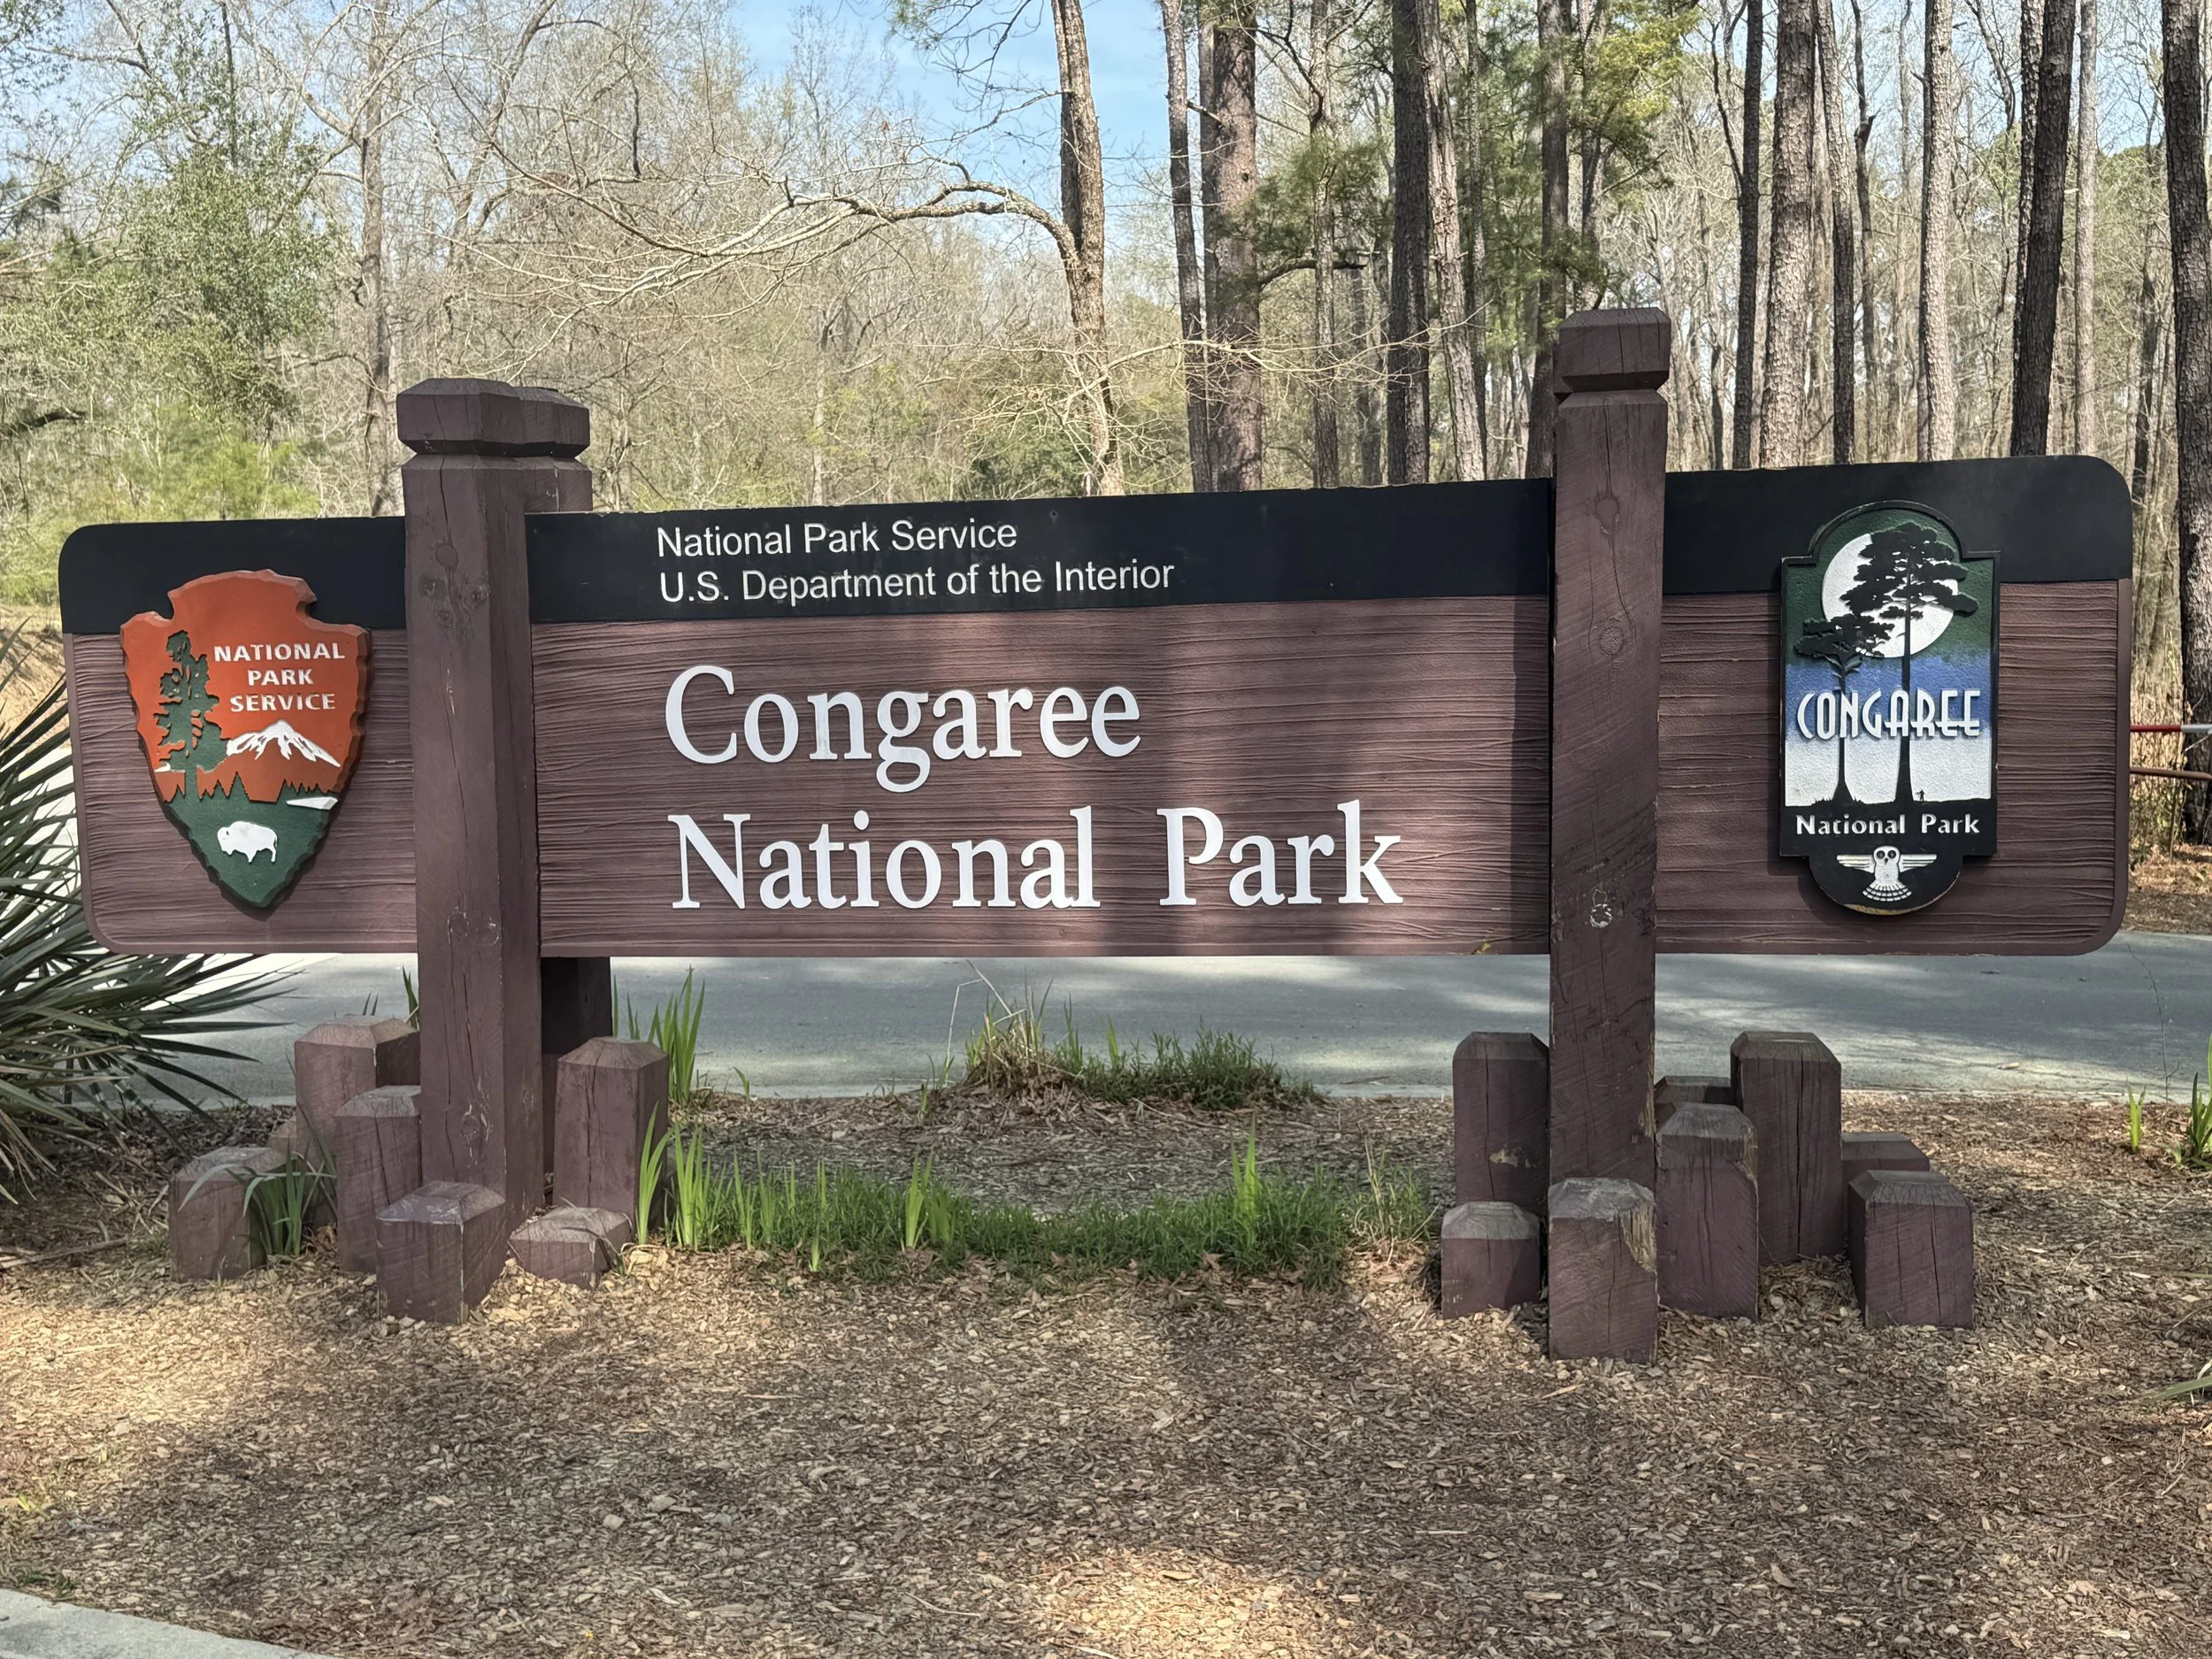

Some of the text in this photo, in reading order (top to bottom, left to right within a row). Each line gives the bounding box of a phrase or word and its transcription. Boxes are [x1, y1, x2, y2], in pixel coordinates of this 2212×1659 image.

[658, 518, 1017, 557] National Park Service
[661, 559, 1174, 606] U.S. Department of the Interior
[214, 643, 345, 662] NATIONAL
[248, 669, 313, 686] PARK
[230, 694, 335, 712] SERVICE
[1798, 690, 1980, 739] CONGAREE
[666, 665, 1141, 792] Congaree
[1796, 814, 1979, 834] National Park
[668, 800, 1404, 909] National Park
